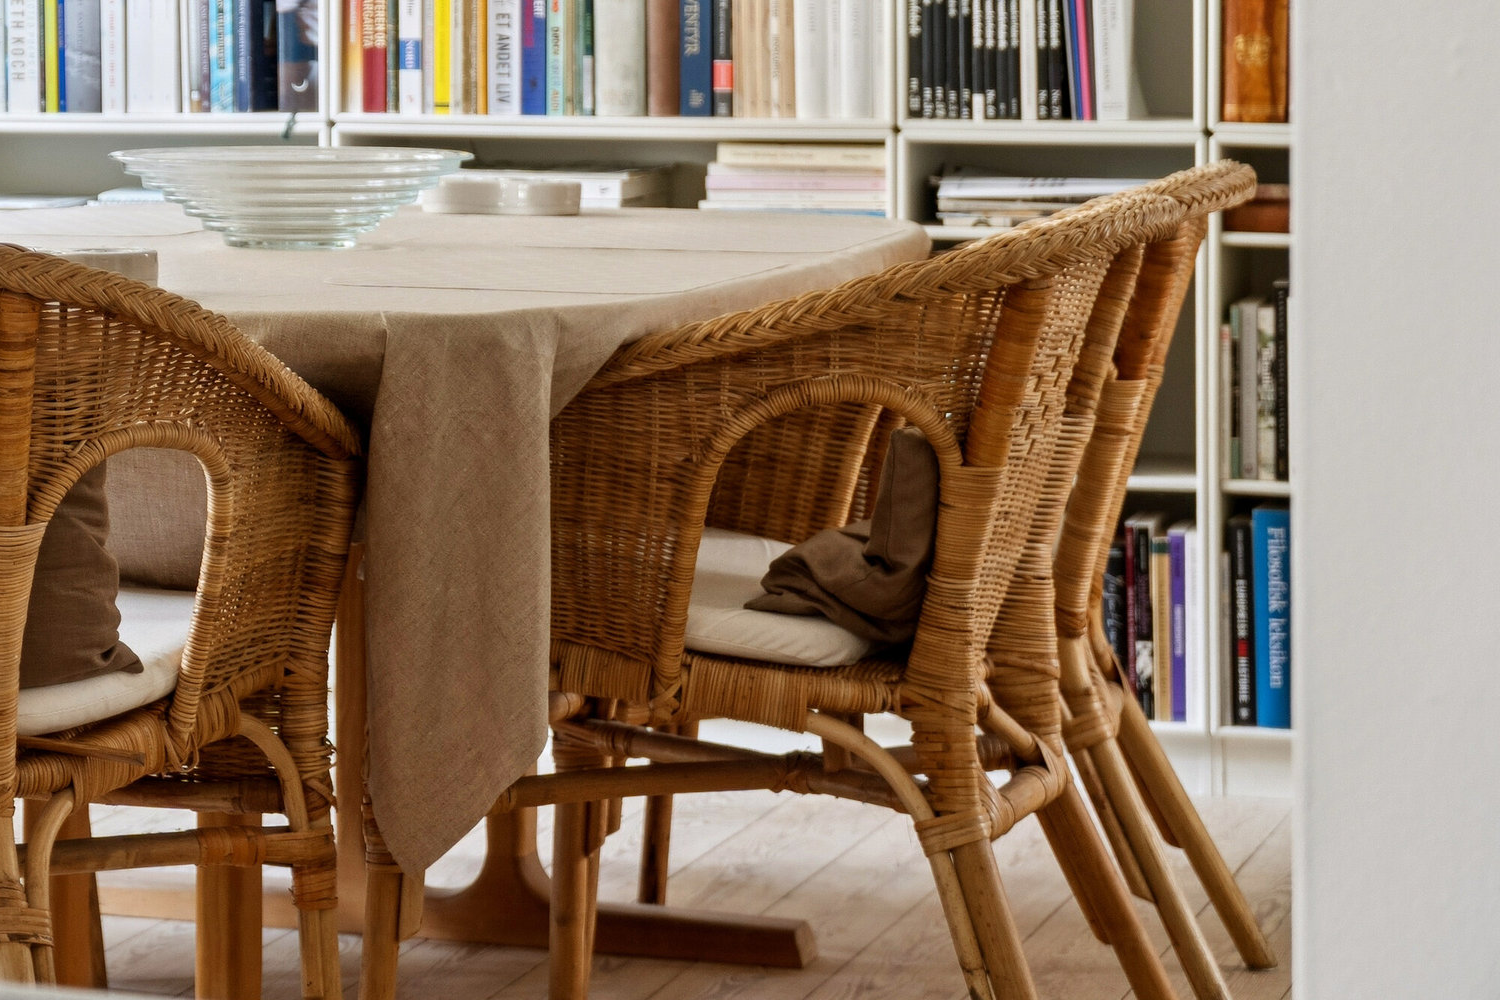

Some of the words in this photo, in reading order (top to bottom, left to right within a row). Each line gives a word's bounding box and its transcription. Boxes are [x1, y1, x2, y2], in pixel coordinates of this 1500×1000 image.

[496, 12, 511, 28] ET
[10, 36, 26, 81] KOCH
[374, 32, 387, 48] OG
[404, 40, 417, 69] NORD
[496, 33, 511, 78] ANDET
[496, 83, 511, 104] LIV
[1267, 527, 1287, 612] Filosofisk
[1268, 617, 1287, 689] leksikon
